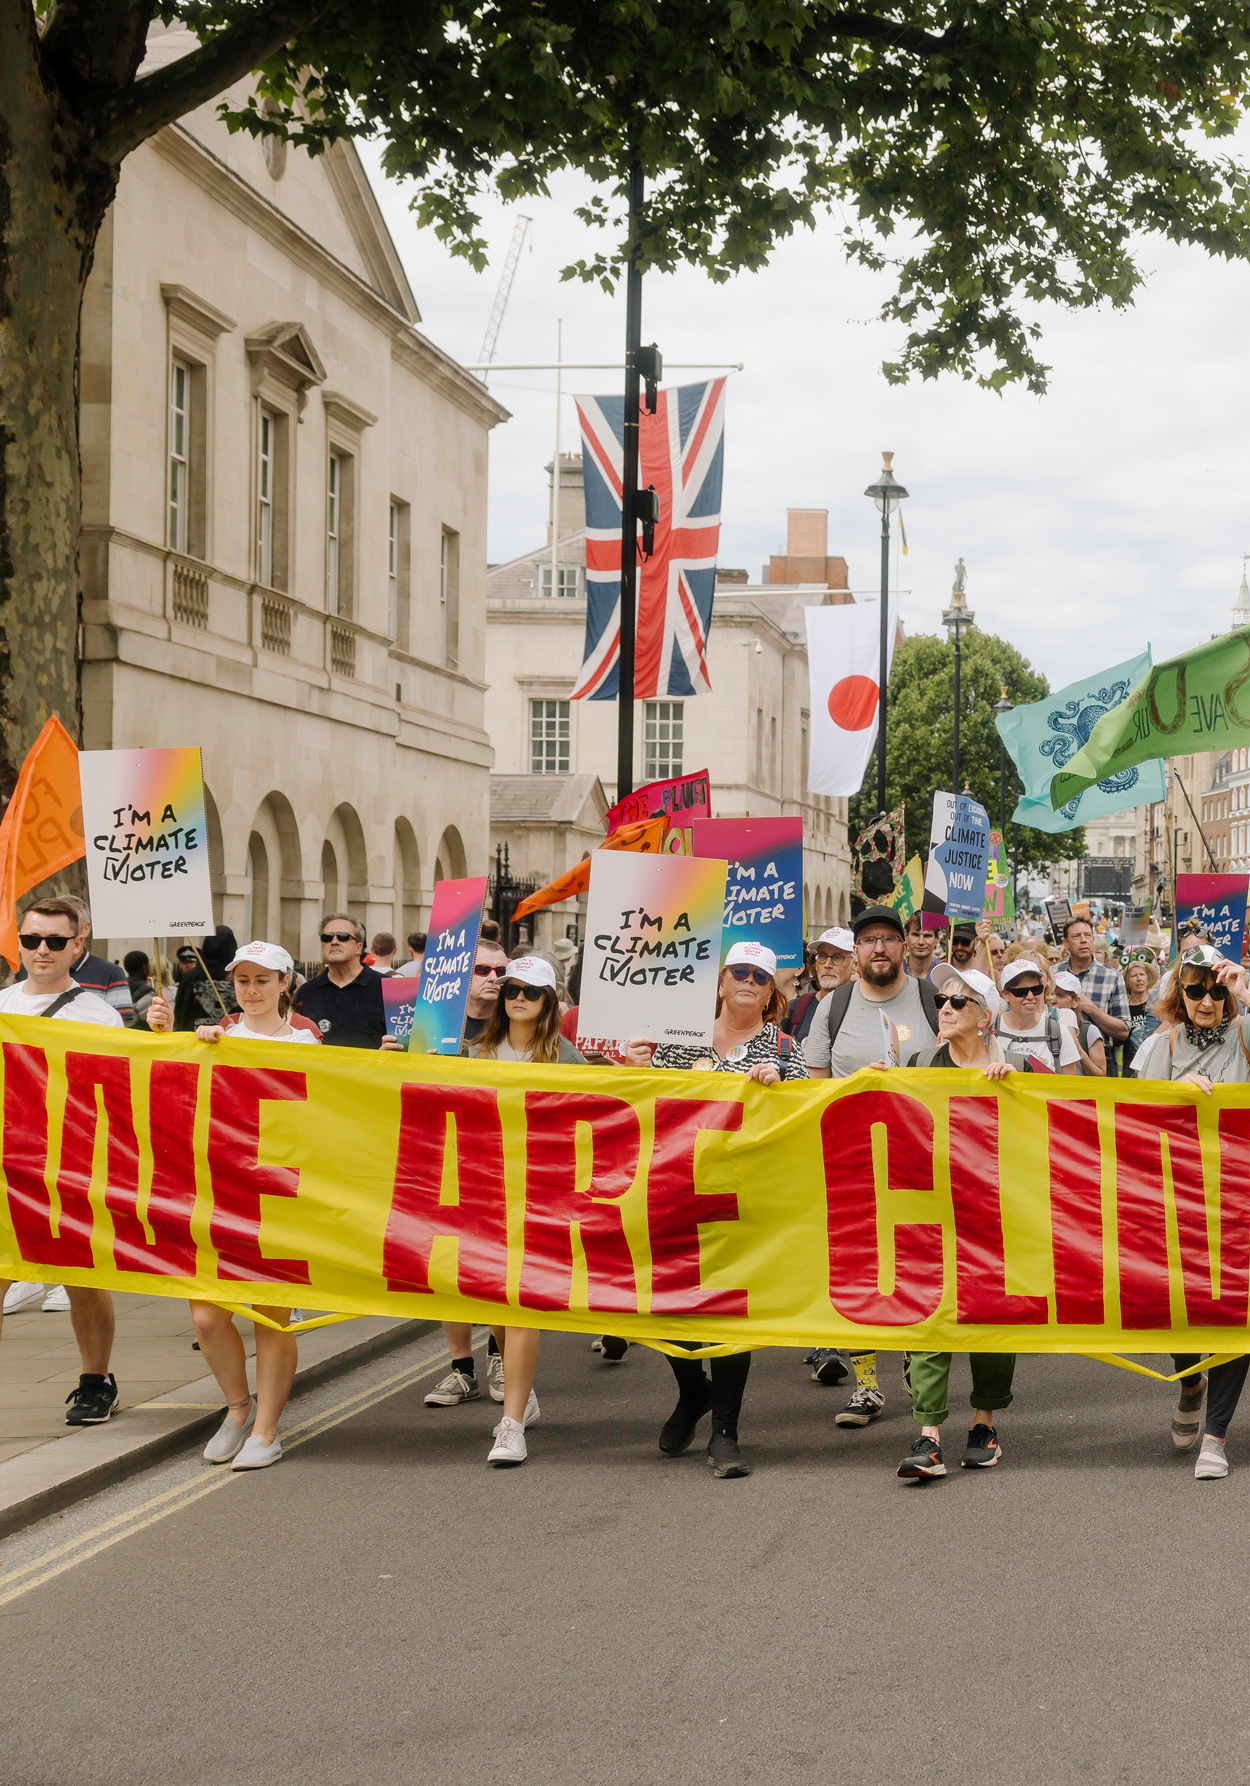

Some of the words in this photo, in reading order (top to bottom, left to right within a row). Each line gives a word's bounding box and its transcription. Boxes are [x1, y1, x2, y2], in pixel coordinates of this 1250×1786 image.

[112, 804, 152, 828] I'M
[160, 804, 177, 823] A
[93, 828, 199, 854] CLIMATE
[945, 825, 986, 848] CLIMATE
[763, 861, 779, 878] A
[944, 849, 983, 870] JUSTICE
[725, 881, 796, 903] IMATE
[949, 871, 974, 891] NOW
[620, 908, 663, 932] I'M
[673, 913, 692, 932] A
[1192, 904, 1215, 918] I'M
[1219, 905, 1230, 917] A
[168, 920, 207, 928] GREENPEACE
[1178, 918, 1241, 933] CIMATE
[436, 929, 454, 952] I'M
[457, 929, 466, 947] A
[594, 934, 712, 960] CLIMATE
[424, 951, 471, 976] CLIMATE
[664, 1028, 706, 1037] GREENPEACE
[2, 1042, 312, 1285] WE
[382, 1081, 749, 1318] ARE
